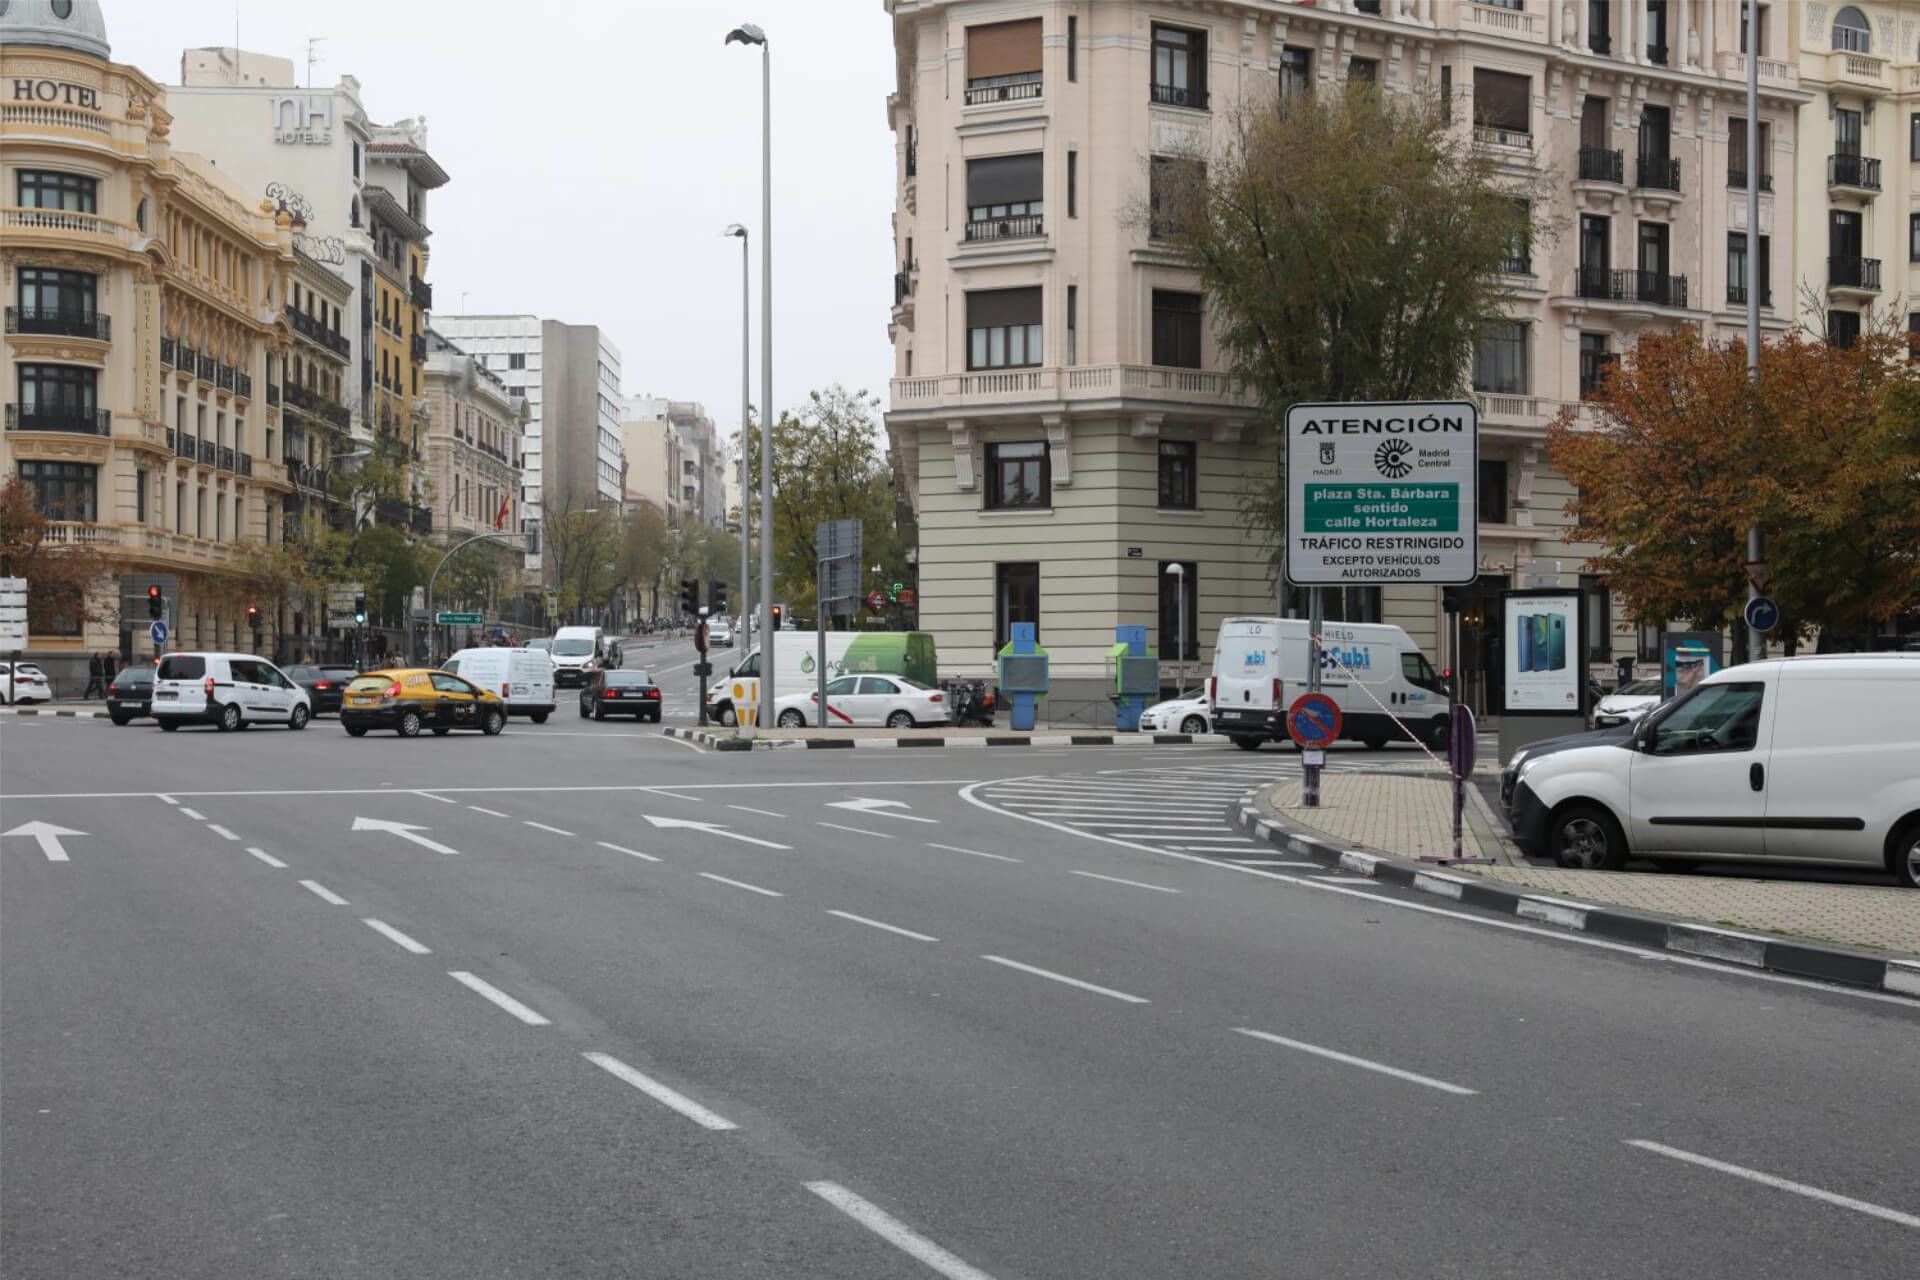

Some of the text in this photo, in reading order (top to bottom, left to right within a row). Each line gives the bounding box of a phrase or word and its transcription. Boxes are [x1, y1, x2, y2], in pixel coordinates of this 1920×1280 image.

[13, 79, 102, 111] HOTEL
[274, 132, 331, 145] HOTELS
[1301, 414, 1463, 434] ATENCIÓN
[1418, 449, 1450, 458] Madrid
[1418, 459, 1450, 467] Central
[1314, 488, 1352, 500] plaza
[1357, 488, 1385, 499] Sta.
[1354, 502, 1409, 513] sentido
[1325, 517, 1438, 528] calle Hortaleza
[1300, 536, 1465, 550] TRÁFICO RESTRINGIDO
[1322, 556, 1374, 565] EXCEPTO
[1341, 568, 1421, 578] AUTORIZADOS
[1324, 631, 1354, 640] HIELO
